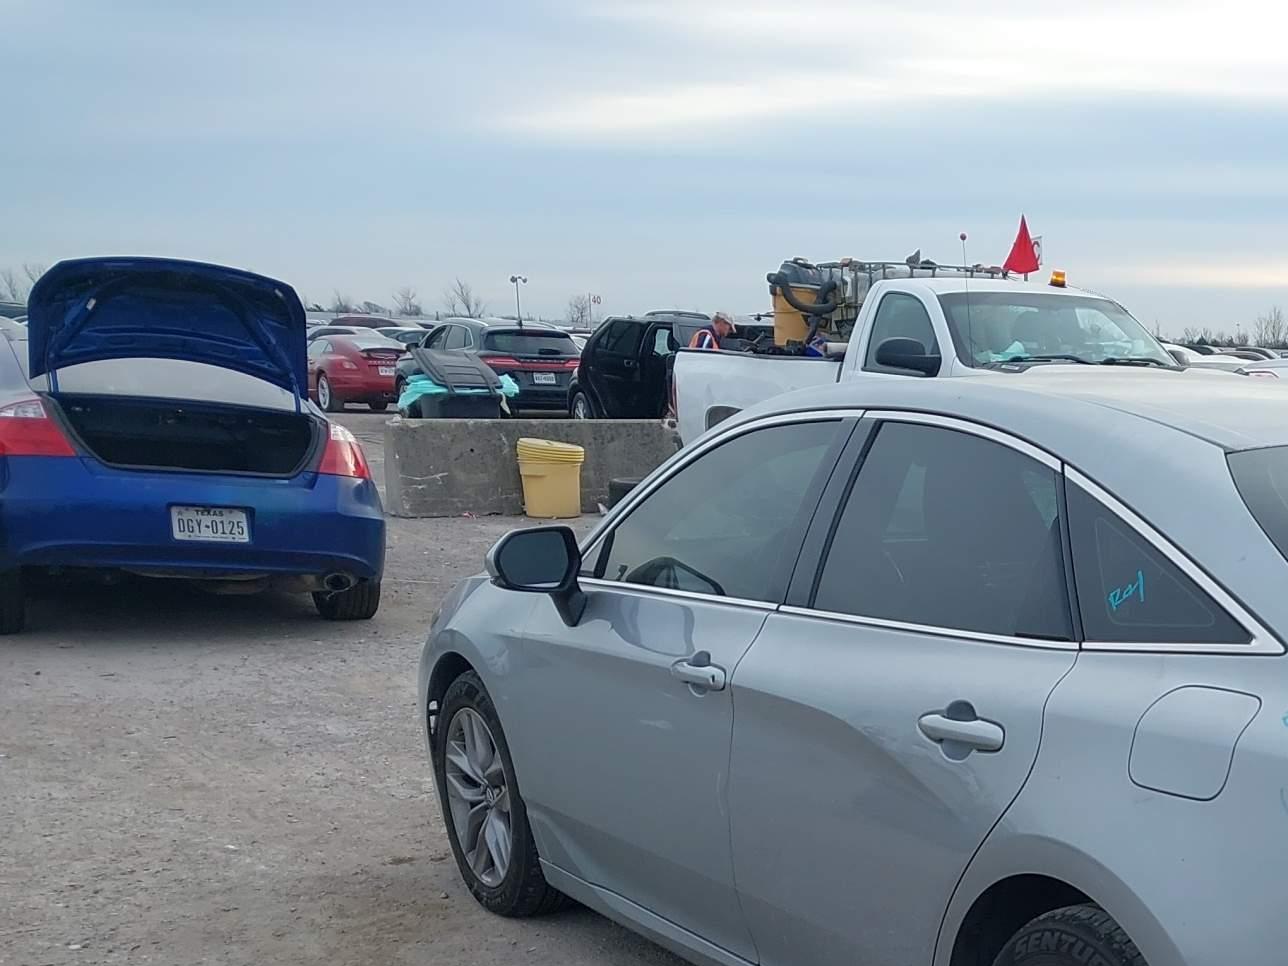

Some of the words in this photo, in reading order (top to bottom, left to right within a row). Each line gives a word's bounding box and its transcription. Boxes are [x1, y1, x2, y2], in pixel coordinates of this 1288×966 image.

[592, 295, 602, 305] 40
[195, 509, 224, 517] TEXAS
[178, 518, 244, 536] DGY-0125
